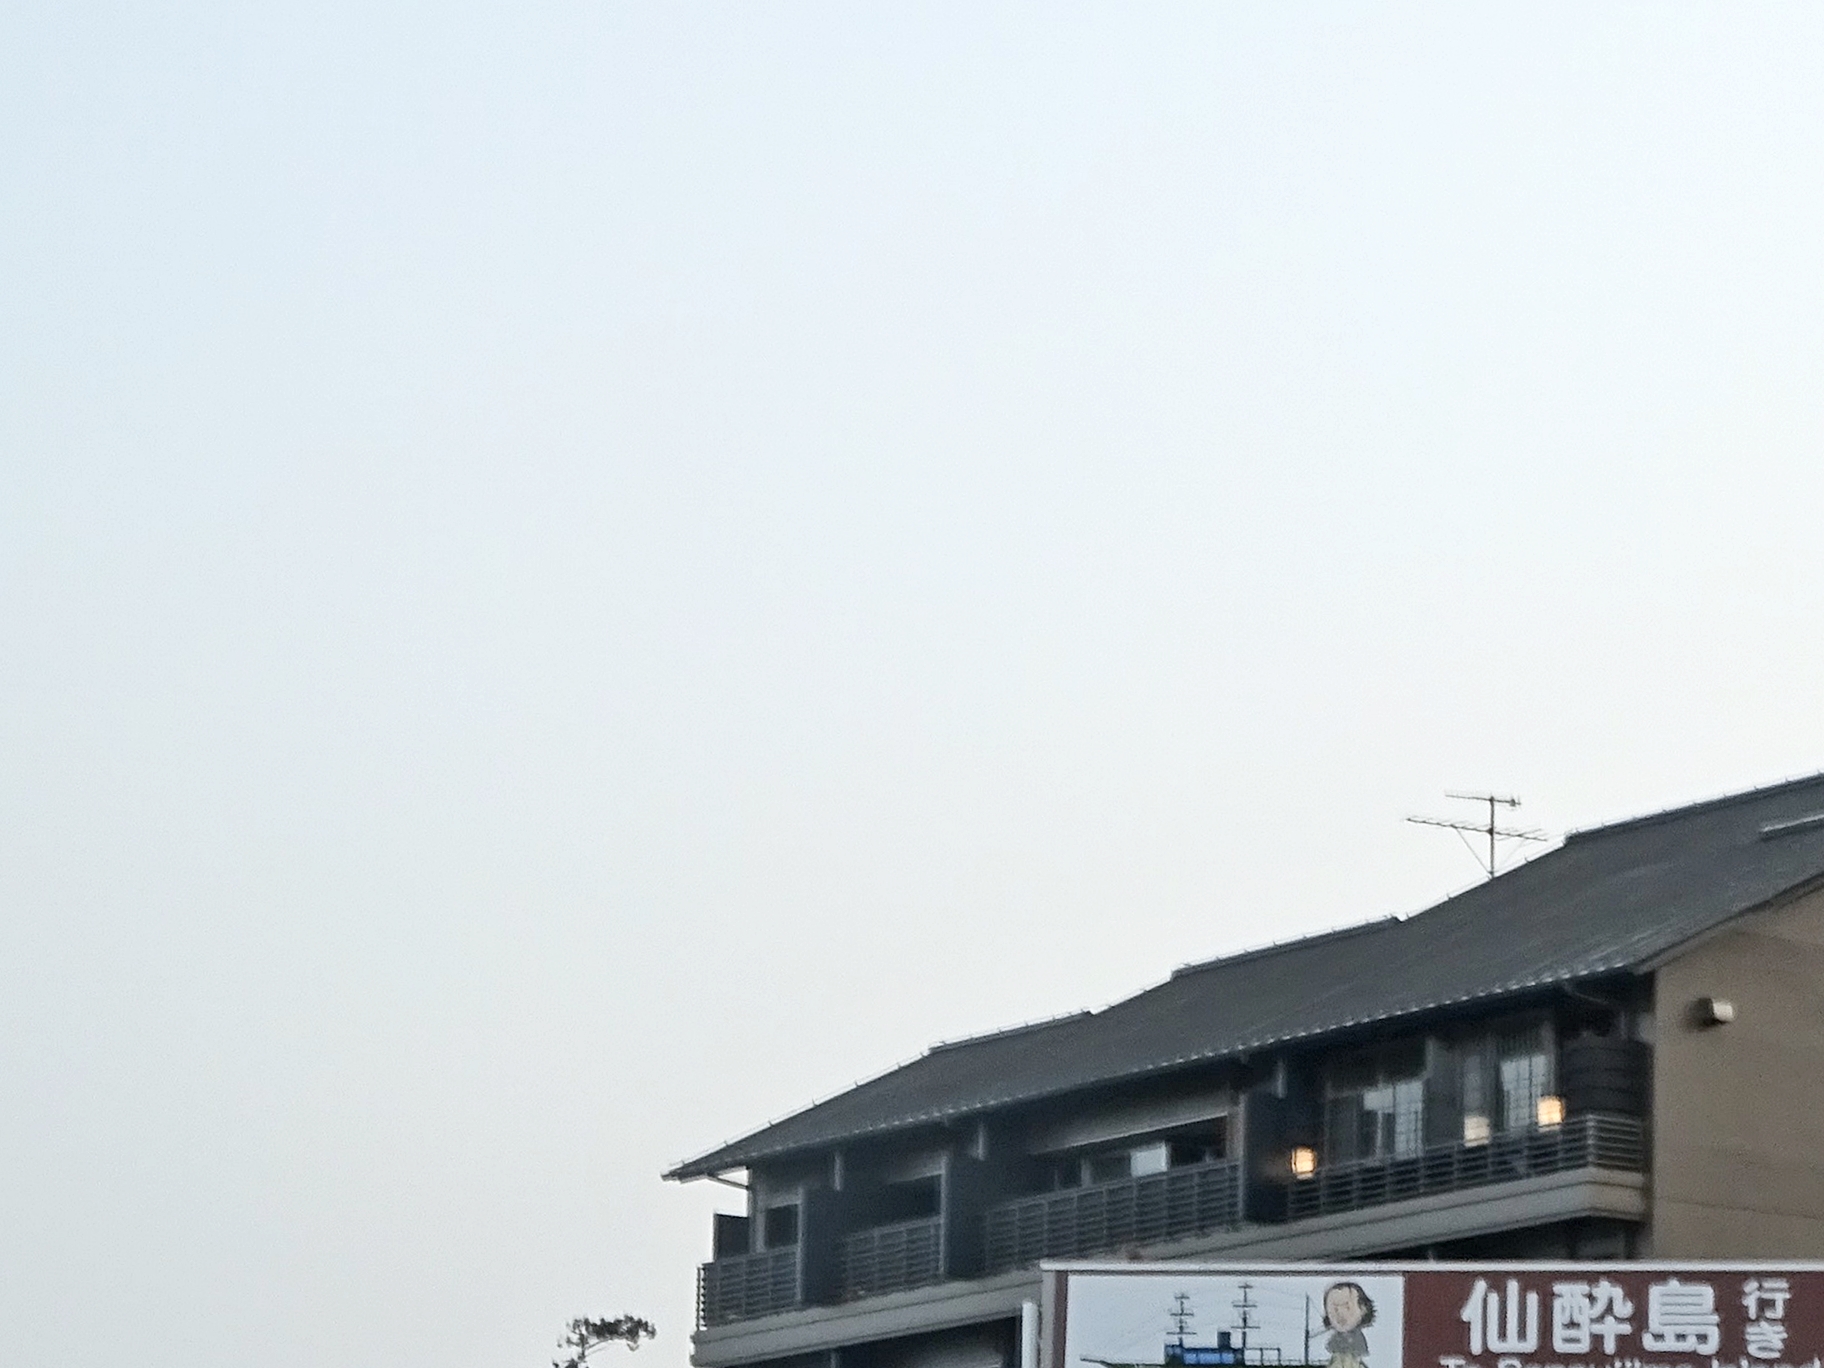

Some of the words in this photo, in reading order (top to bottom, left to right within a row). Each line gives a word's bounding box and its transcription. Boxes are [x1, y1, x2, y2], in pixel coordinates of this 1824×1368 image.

[1460, 1277, 1720, 1356] 仙酔島
[1741, 1278, 1791, 1359] 行き
